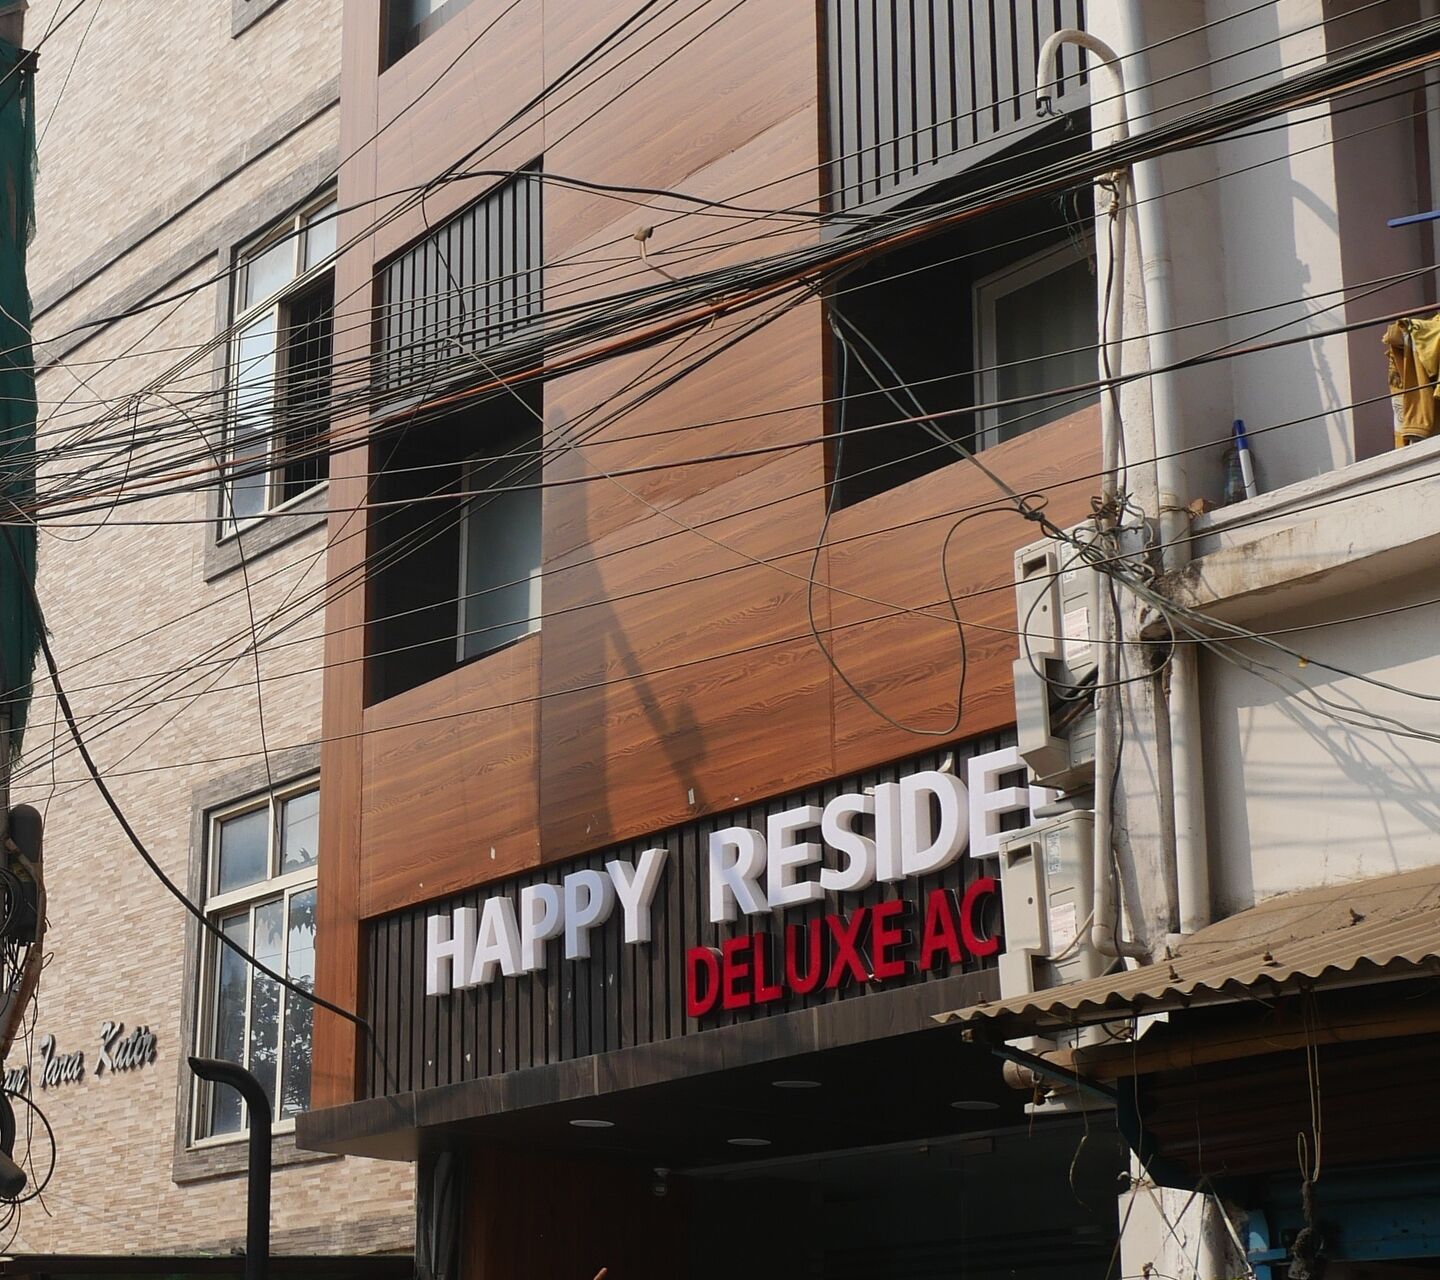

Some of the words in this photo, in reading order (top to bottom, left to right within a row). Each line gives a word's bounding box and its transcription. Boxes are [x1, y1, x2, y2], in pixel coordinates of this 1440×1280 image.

[426, 847, 668, 996] HAPPY
[687, 898, 912, 1019] DELUXE
[918, 876, 1001, 971] AC
